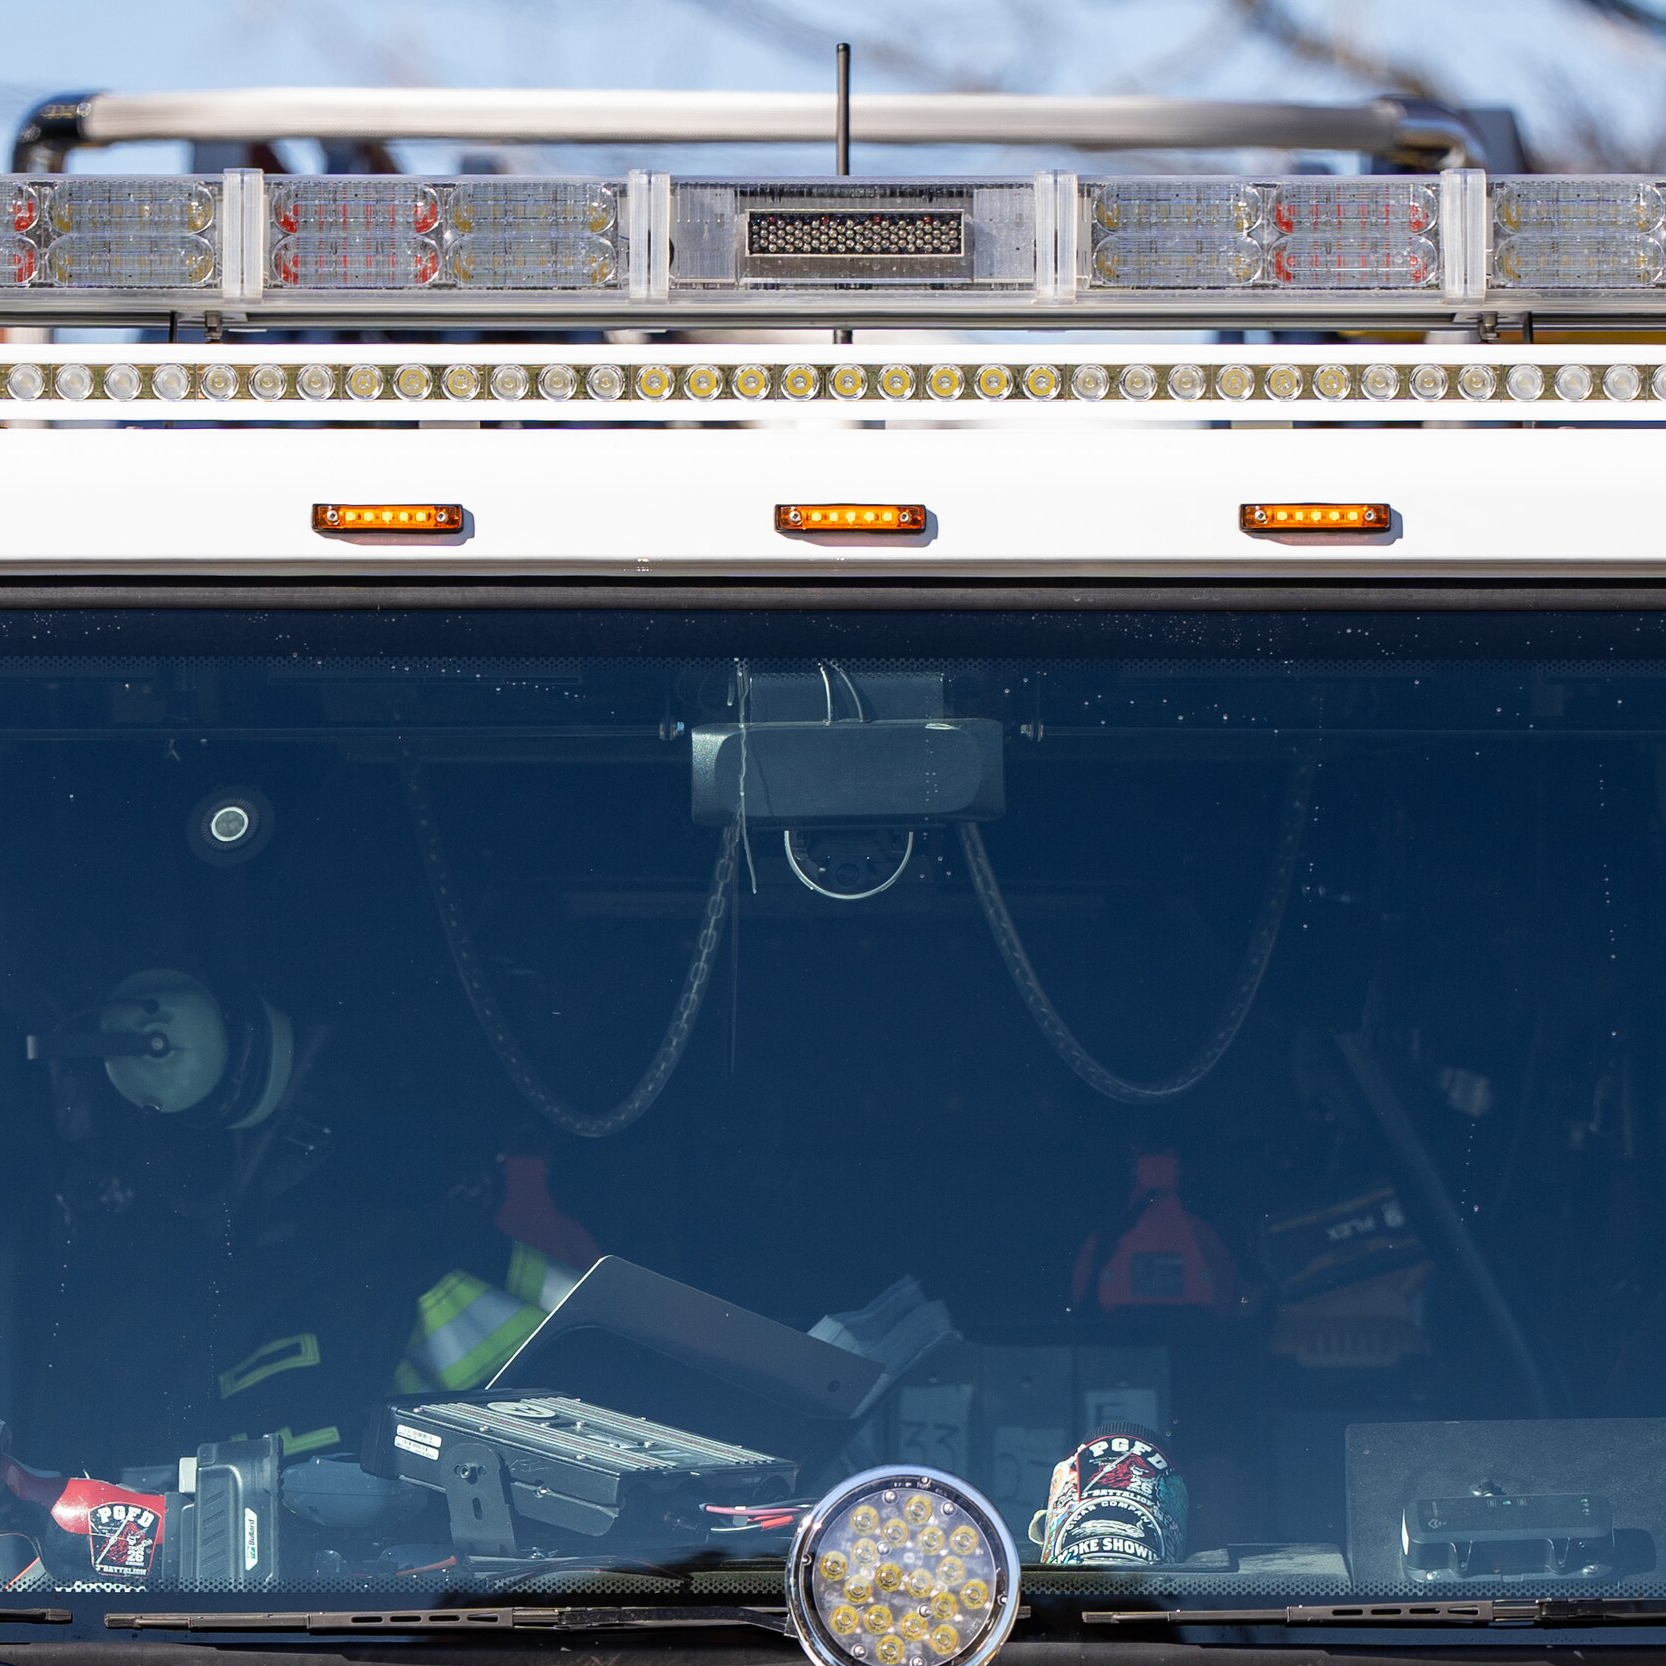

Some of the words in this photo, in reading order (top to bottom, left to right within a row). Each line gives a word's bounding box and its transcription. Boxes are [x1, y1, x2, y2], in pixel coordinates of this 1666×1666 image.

[1088, 1437, 1168, 1470] PGFD
[1129, 1478, 1153, 1494] 26
[97, 1505, 155, 1528] PGFD
[1066, 1505, 1097, 1532] CIGAR
[1101, 1501, 1155, 1529] COMPANY
